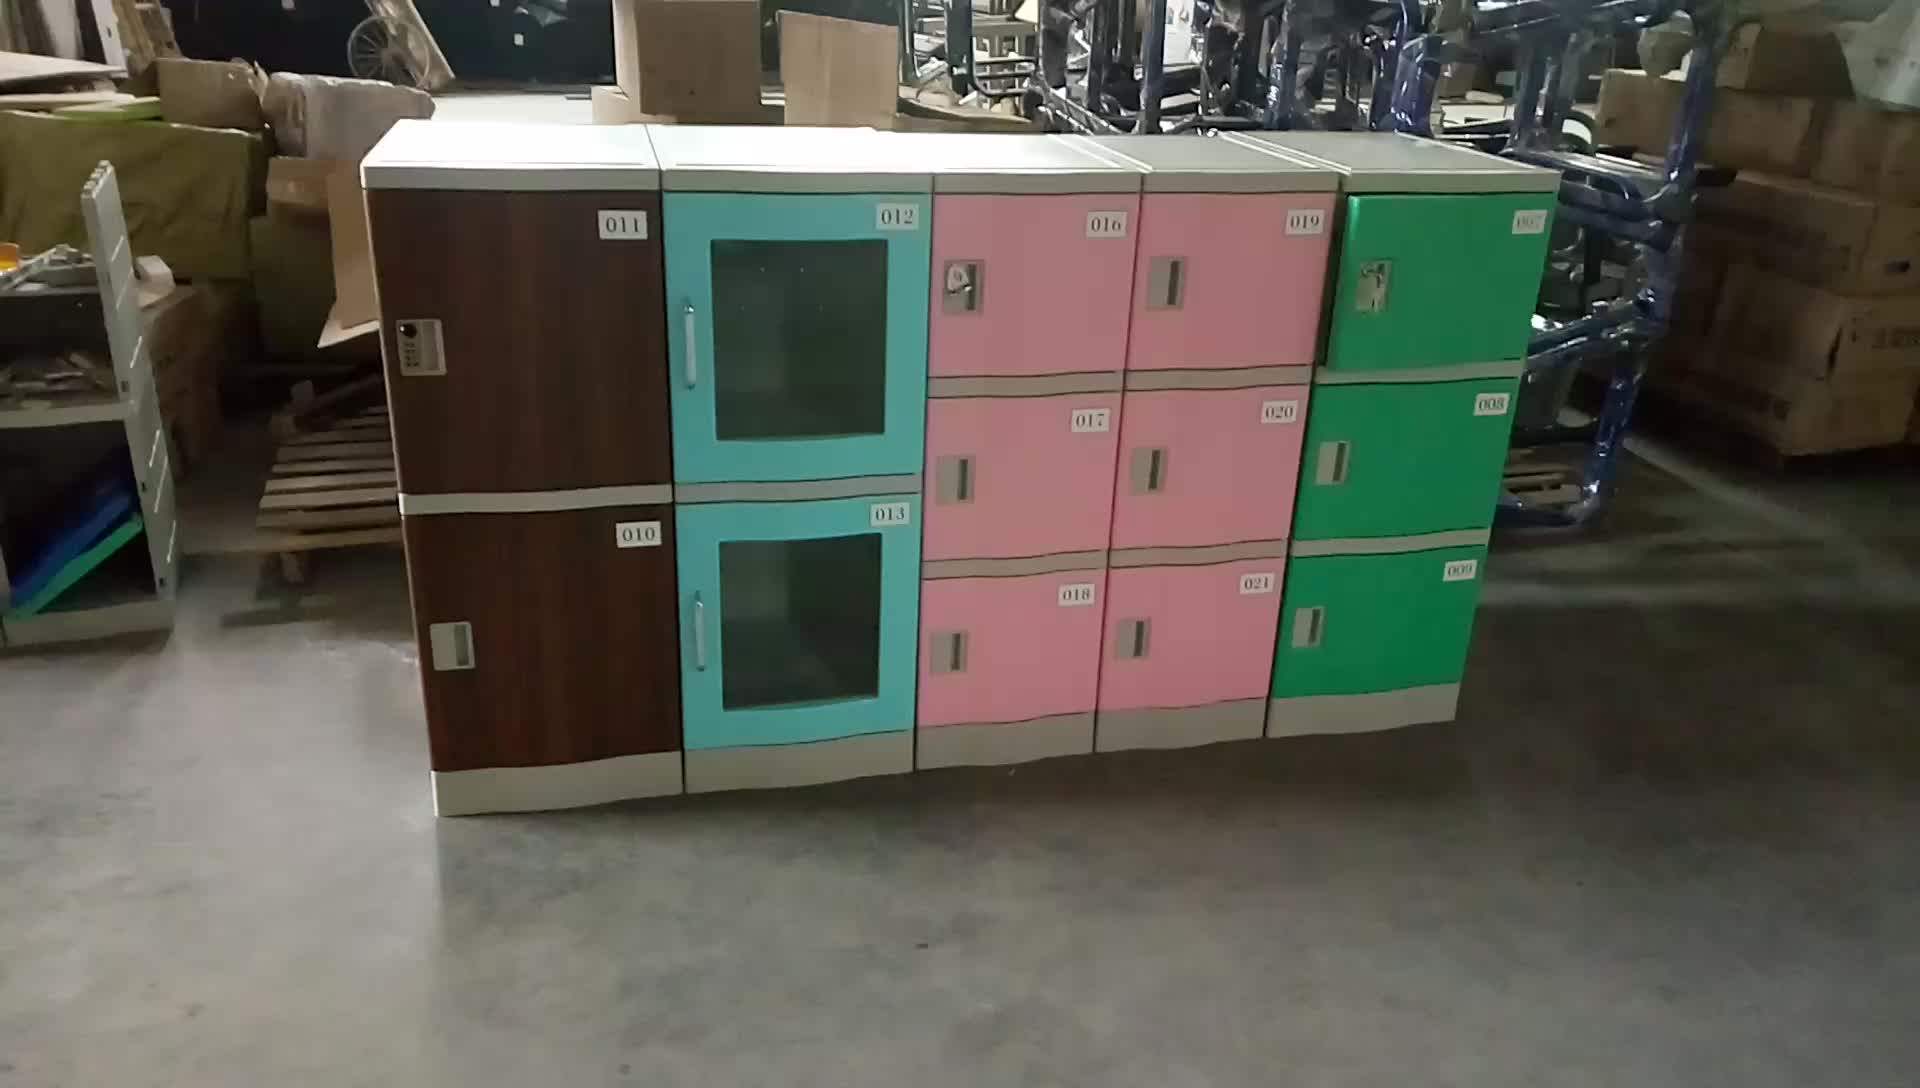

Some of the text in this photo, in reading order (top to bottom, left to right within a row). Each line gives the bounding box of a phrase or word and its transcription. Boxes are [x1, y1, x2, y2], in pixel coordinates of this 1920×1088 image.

[881, 208, 913, 225] 012
[1090, 215, 1122, 232] 016
[1289, 214, 1320, 229] 019
[605, 216, 639, 233] 011
[1265, 405, 1294, 419] 020
[1075, 413, 1105, 428] 017
[875, 507, 905, 521] 013
[622, 526, 656, 542] 010
[1243, 576, 1269, 590] 021
[1062, 588, 1091, 601] 018
